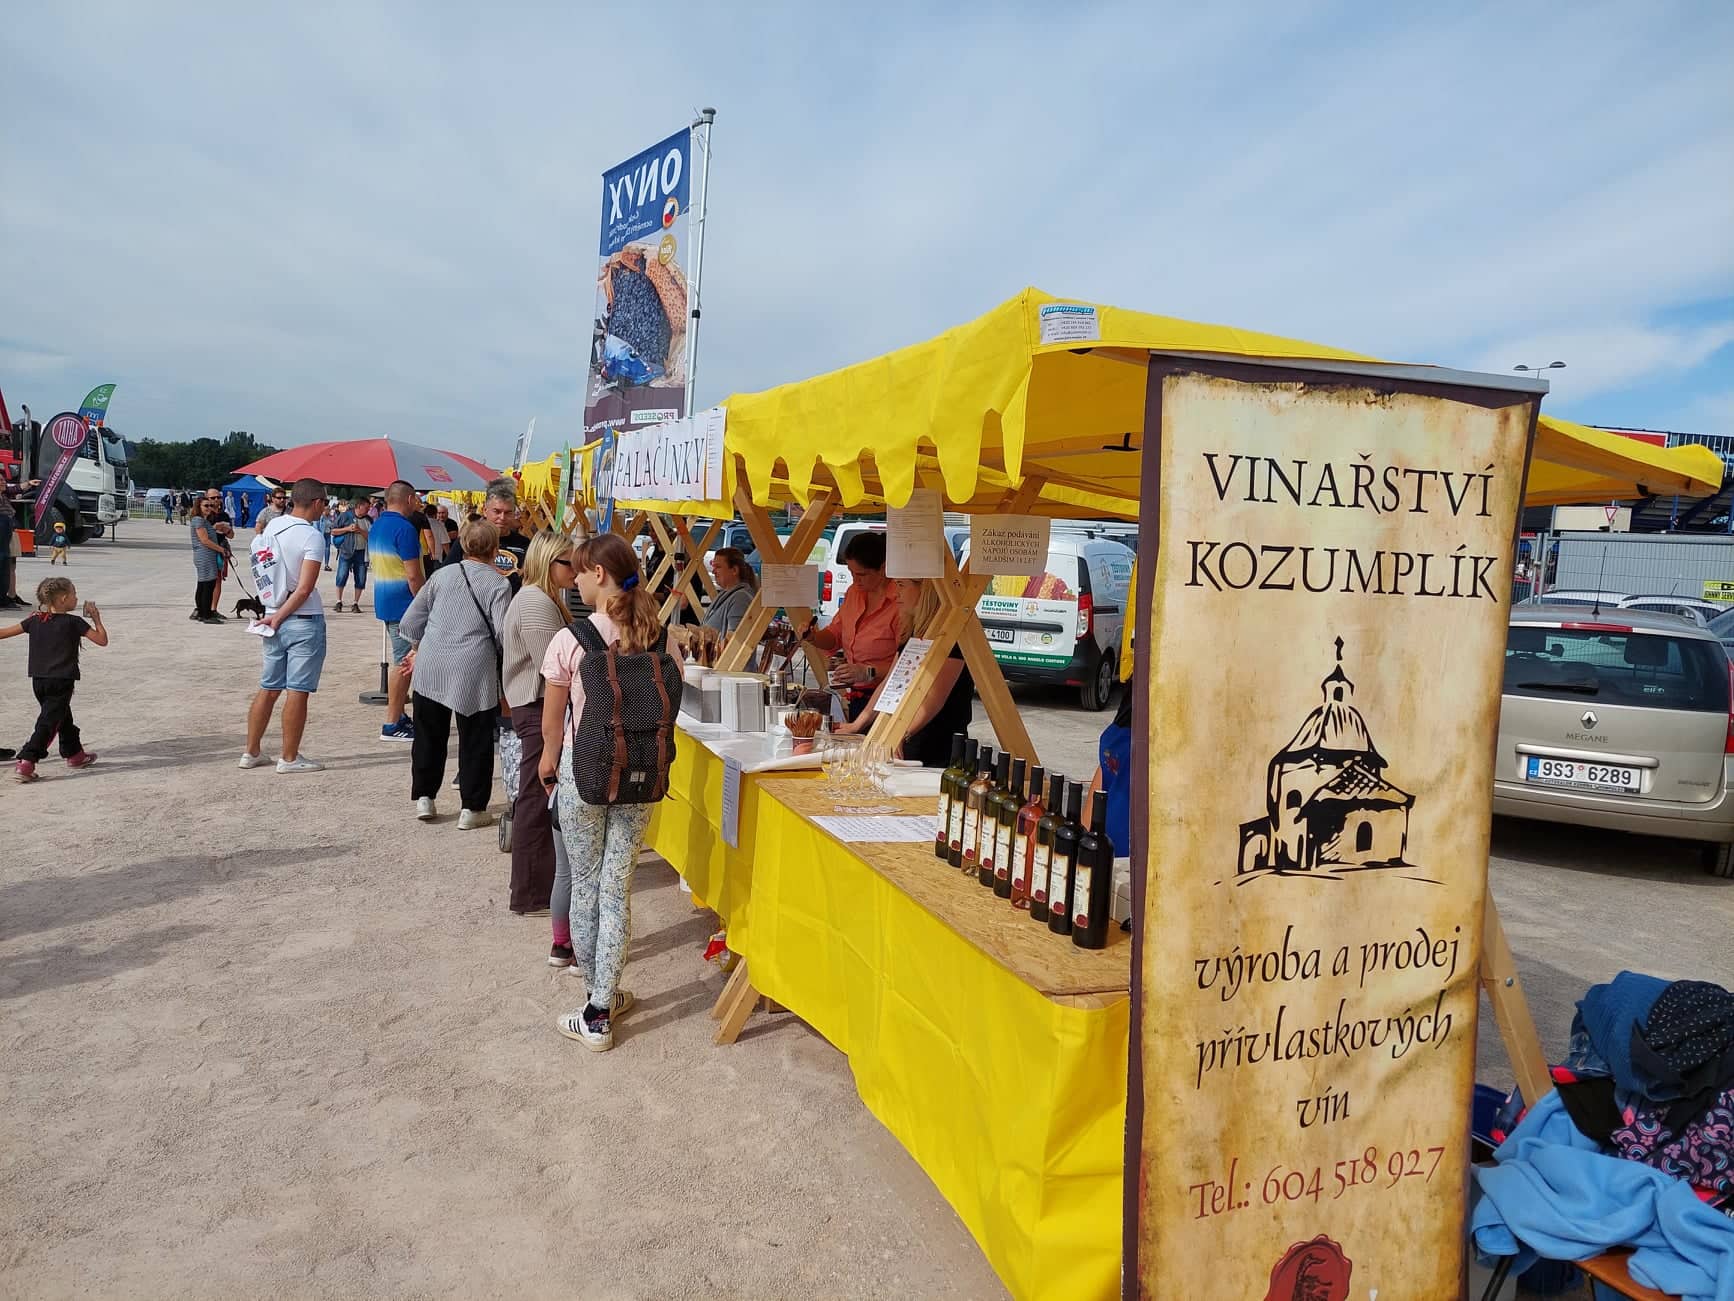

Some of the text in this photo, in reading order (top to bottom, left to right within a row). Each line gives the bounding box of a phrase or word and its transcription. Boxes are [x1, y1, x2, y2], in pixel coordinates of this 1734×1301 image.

[56, 419, 79, 446] TATRA
[1202, 453, 1495, 517] VINAŘSTVÍ
[982, 528, 1040, 540] Zákaz podávání
[495, 555, 513, 564] NYX
[1184, 540, 1499, 603] KOZUMPLÍK
[981, 600, 1019, 609] TĚSTOVINY
[991, 630, 1010, 640] 4100
[1566, 733, 1609, 744] MEGANE
[1542, 761, 1574, 779] 9S3
[1587, 766, 1632, 786] 6289
[1193, 925, 1461, 1002] výroba a prodej
[1195, 989, 1453, 1089] přívlastkových
[1296, 1086, 1350, 1129] vín
[1188, 1146, 1446, 1220] Tel.: 604 518 927
